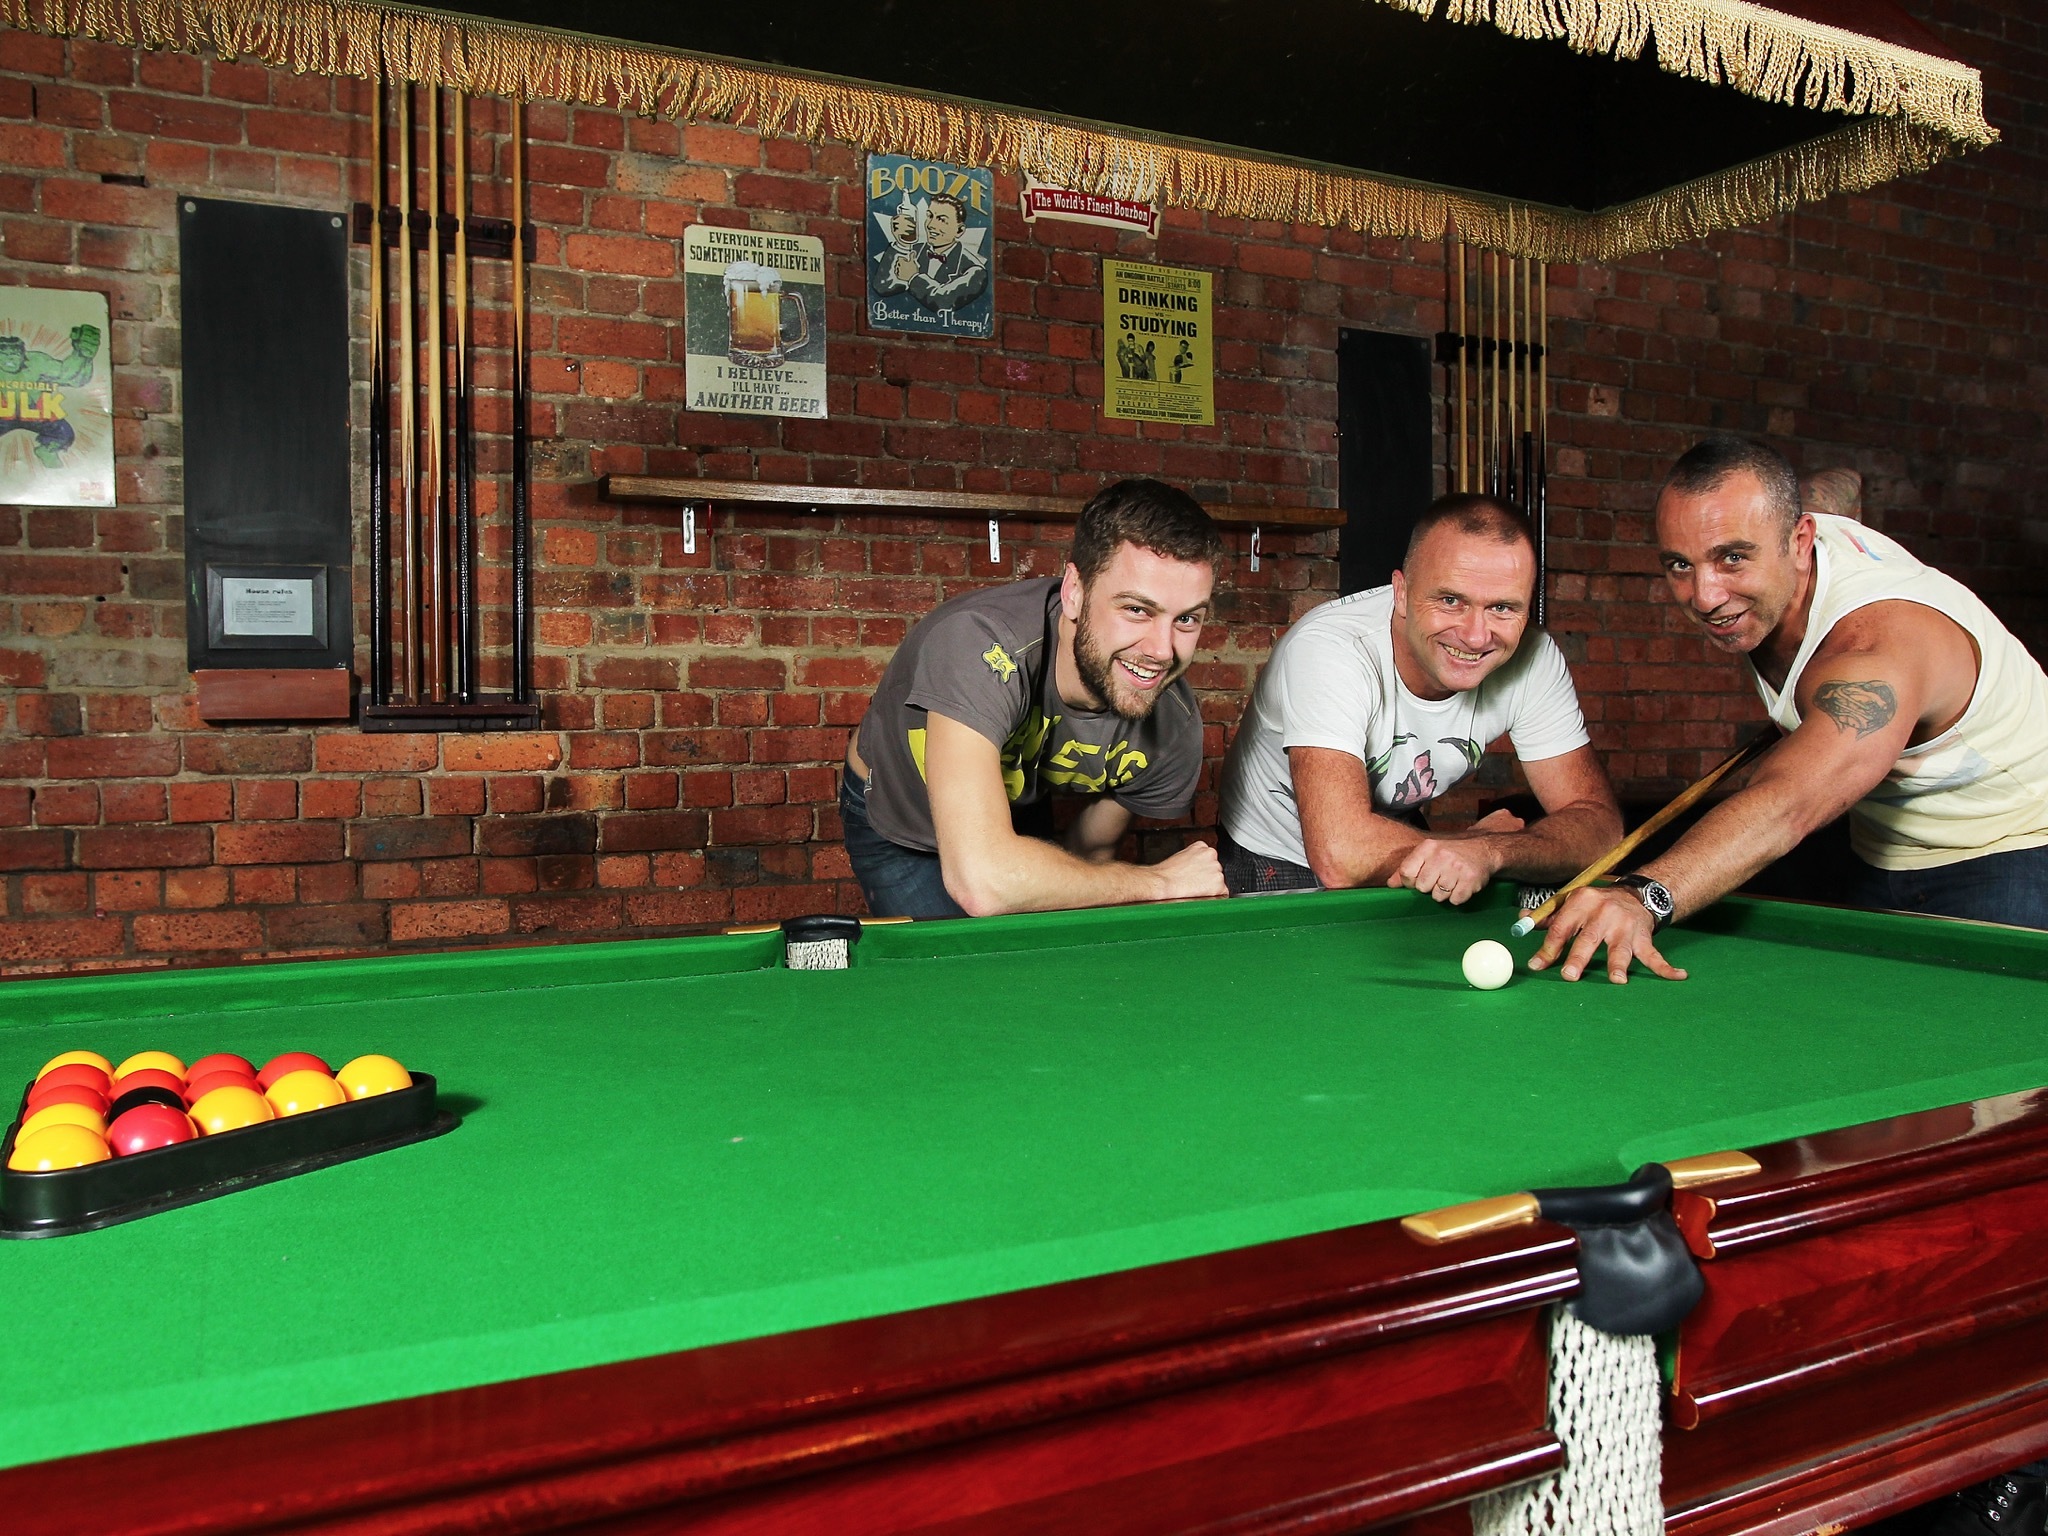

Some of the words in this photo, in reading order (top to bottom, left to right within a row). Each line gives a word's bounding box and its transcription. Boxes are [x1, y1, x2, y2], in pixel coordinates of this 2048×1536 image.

[871, 164, 989, 216] BOOZE
[1035, 192, 1052, 207] The
[1053, 193, 1085, 211] World's
[1086, 197, 1113, 215] Finest
[1114, 201, 1148, 222] Bourbon
[709, 231, 763, 248] EVERYONE
[766, 237, 809, 253] NEEDS...
[690, 245, 749, 263] SOMETHING
[751, 251, 764, 267] TO
[767, 253, 808, 271] BELIEVE
[810, 257, 821, 272] IN
[1118, 287, 1198, 313] DRINKING
[873, 299, 910, 321] Better
[912, 307, 936, 324] than
[937, 308, 990, 334] Therapy!
[1120, 313, 1197, 338] STUDYING
[717, 366, 723, 378] I
[0, 380, 59, 391] NCREDIBLE
[732, 381, 751, 393] I'LL
[0, 390, 68, 420] ULK
[695, 391, 774, 410] ANOTHER
[778, 396, 820, 414] BEER
